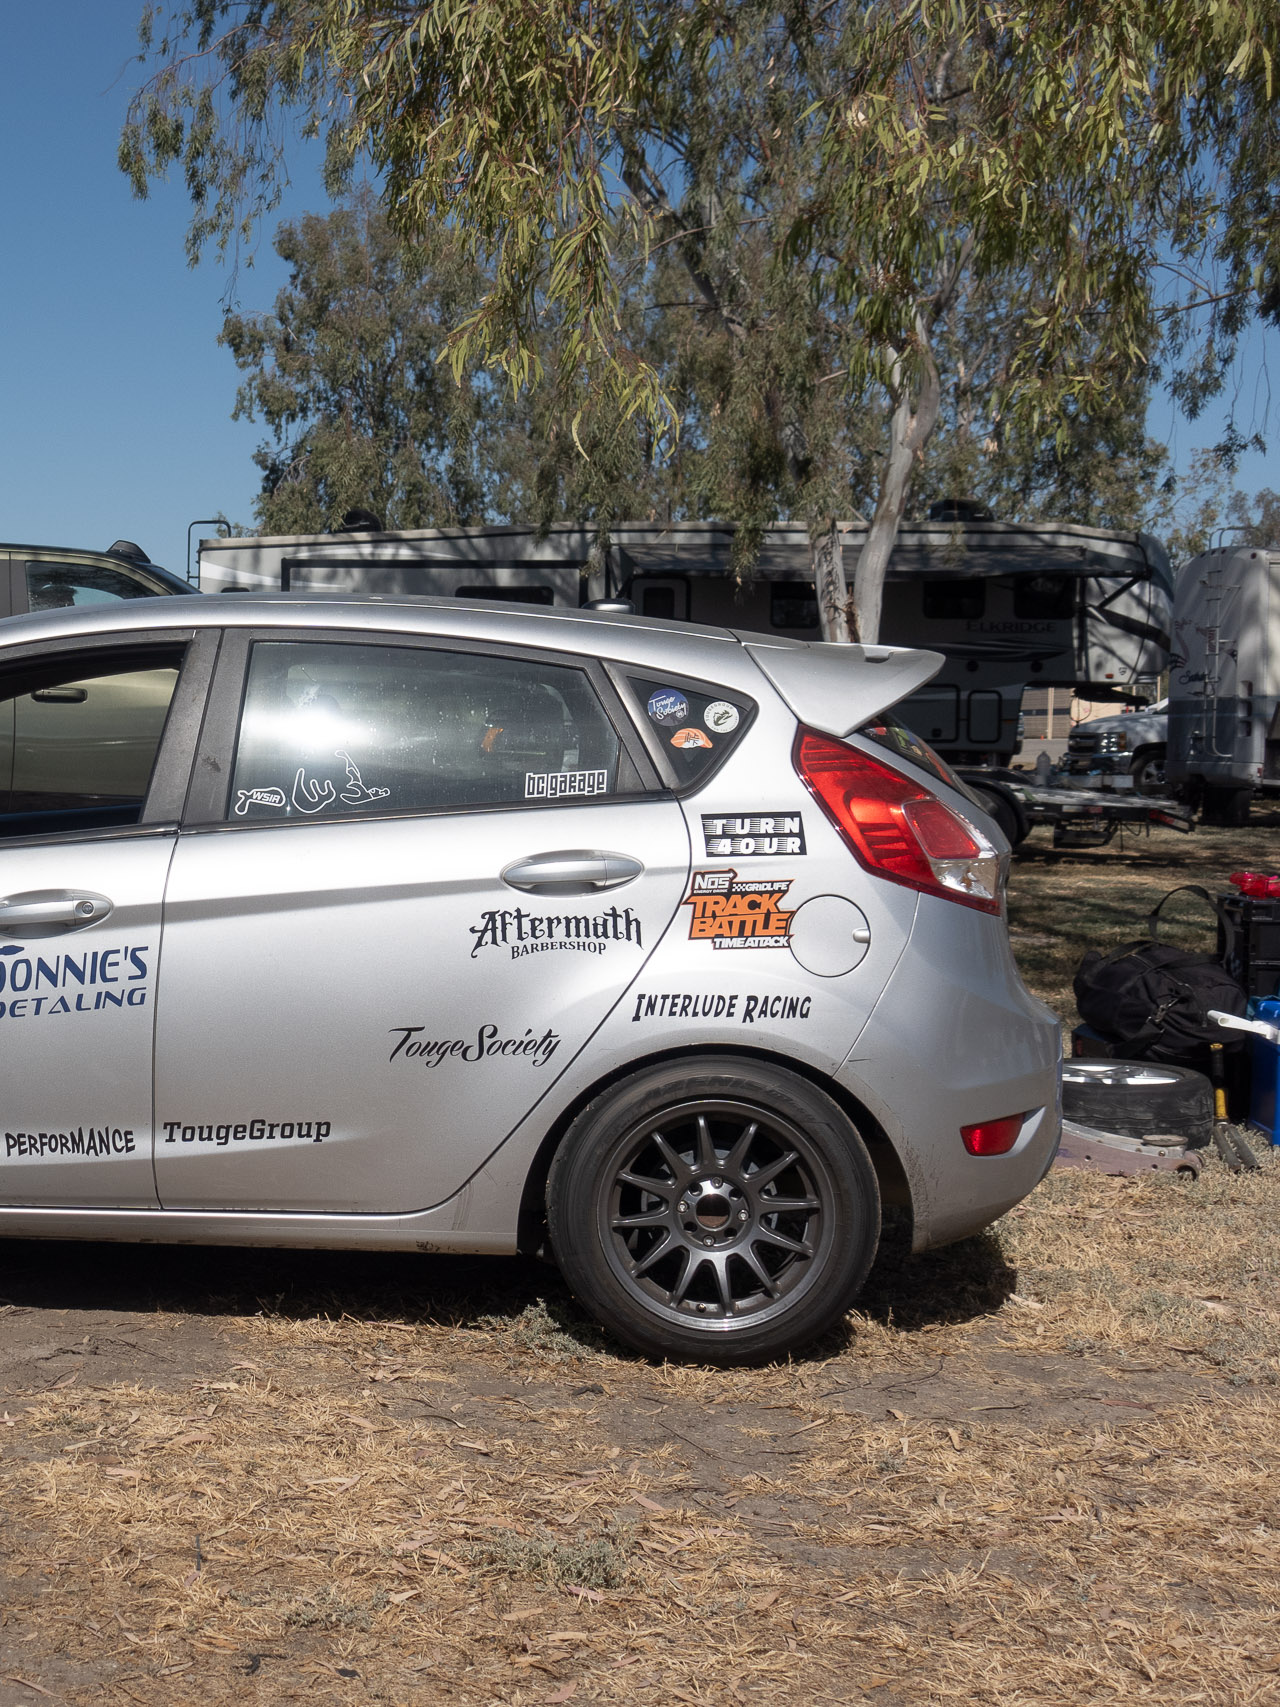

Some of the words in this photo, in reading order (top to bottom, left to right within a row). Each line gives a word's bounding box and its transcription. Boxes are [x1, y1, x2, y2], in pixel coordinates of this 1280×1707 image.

[965, 620, 1057, 634] ELKRIDGE
[251, 790, 282, 804] WSIR
[710, 817, 800, 835] TURN
[694, 872, 732, 890] NOS
[745, 881, 790, 892] GRIDLIFE
[686, 893, 784, 918] TRACK
[469, 905, 645, 959] Aftermath
[691, 913, 793, 938] BATTLE
[510, 940, 607, 960] BARBERSHOP
[631, 992, 739, 1023] INTERLUDE
[741, 994, 813, 1024] RACING
[5, 1126, 136, 1158] PERFORMANCE
[162, 1118, 332, 1146] TougeGroup
